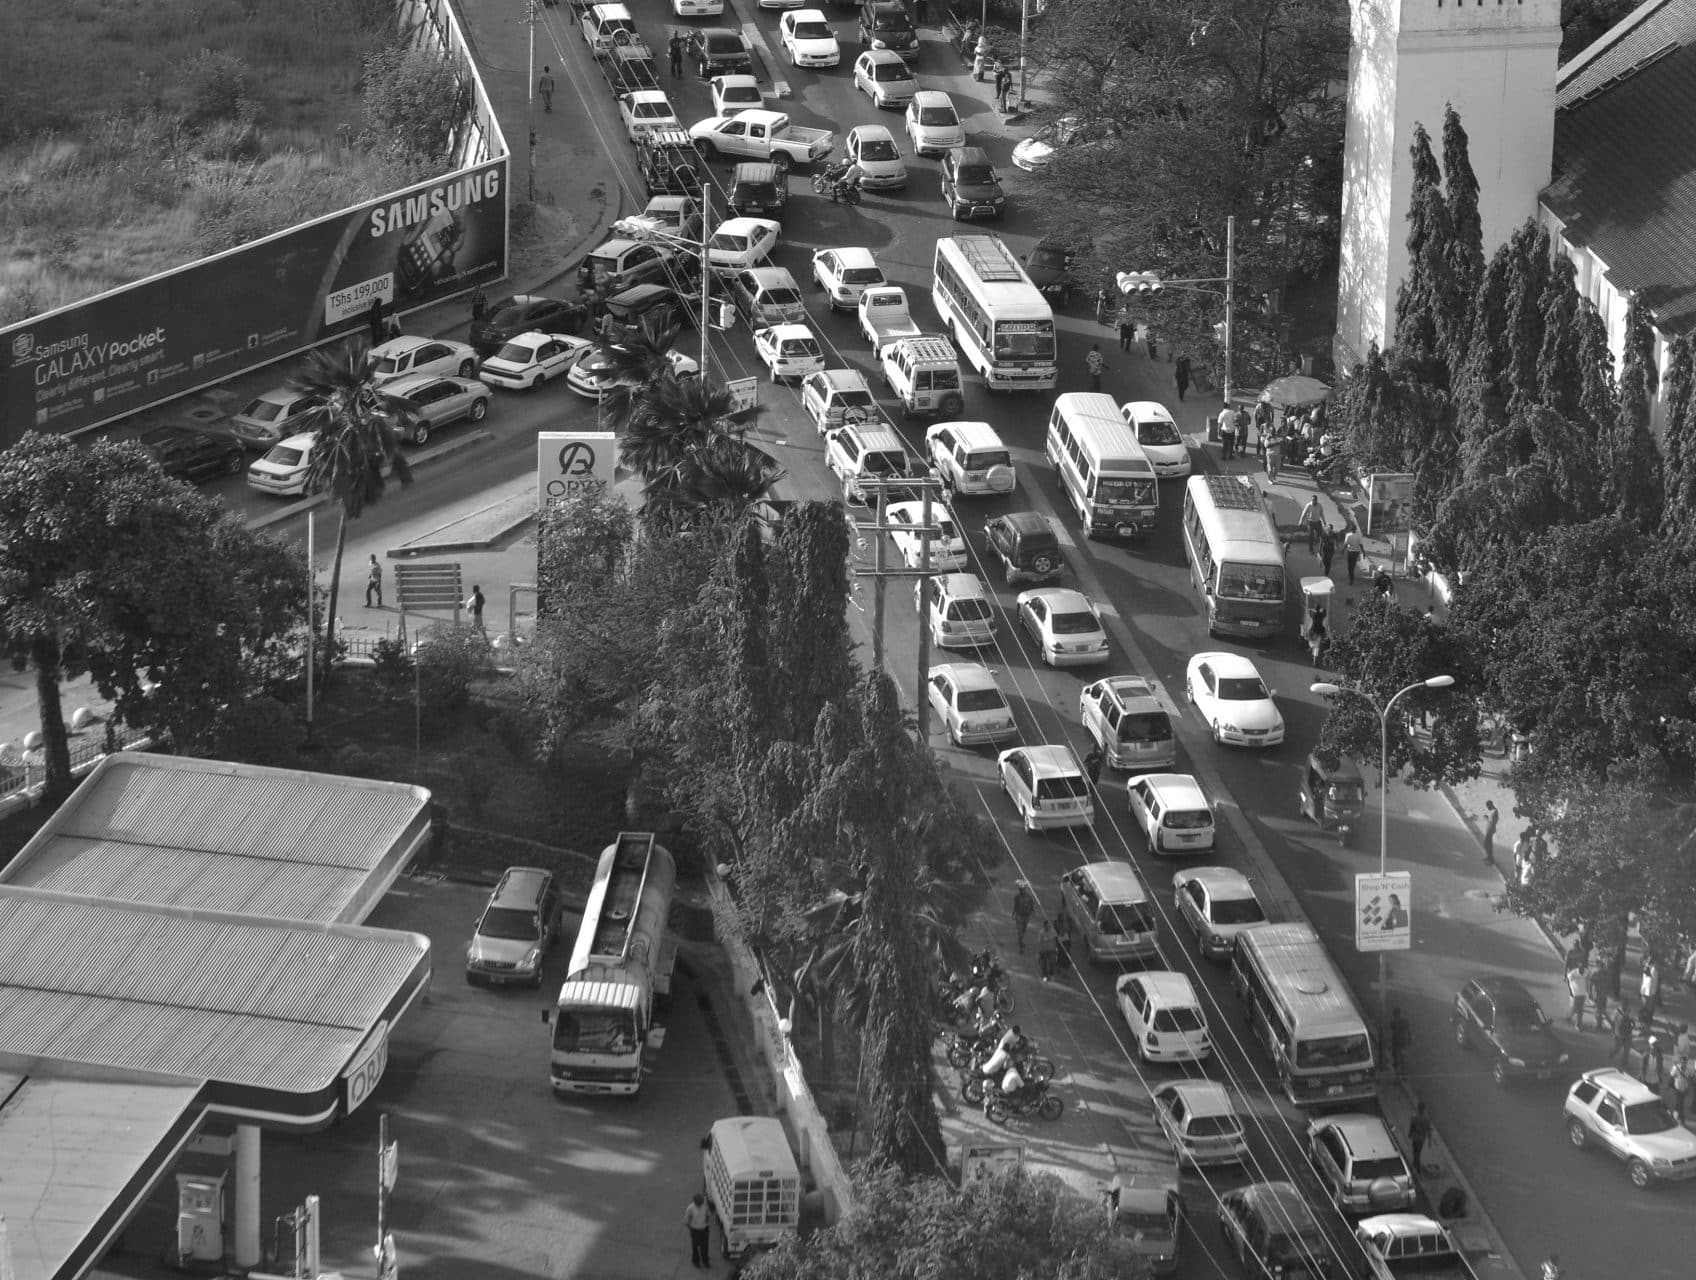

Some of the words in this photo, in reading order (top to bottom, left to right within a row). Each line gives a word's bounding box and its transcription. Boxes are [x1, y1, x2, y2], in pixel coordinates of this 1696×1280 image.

[371, 170, 499, 237] SAMSUNG
[330, 293, 352, 309] TShs
[354, 278, 389, 300] 199,000
[35, 342, 108, 386] GALAXY
[109, 326, 167, 360] Pocket
[36, 333, 89, 361] Samsung
[352, 1042, 387, 1102] ORY
